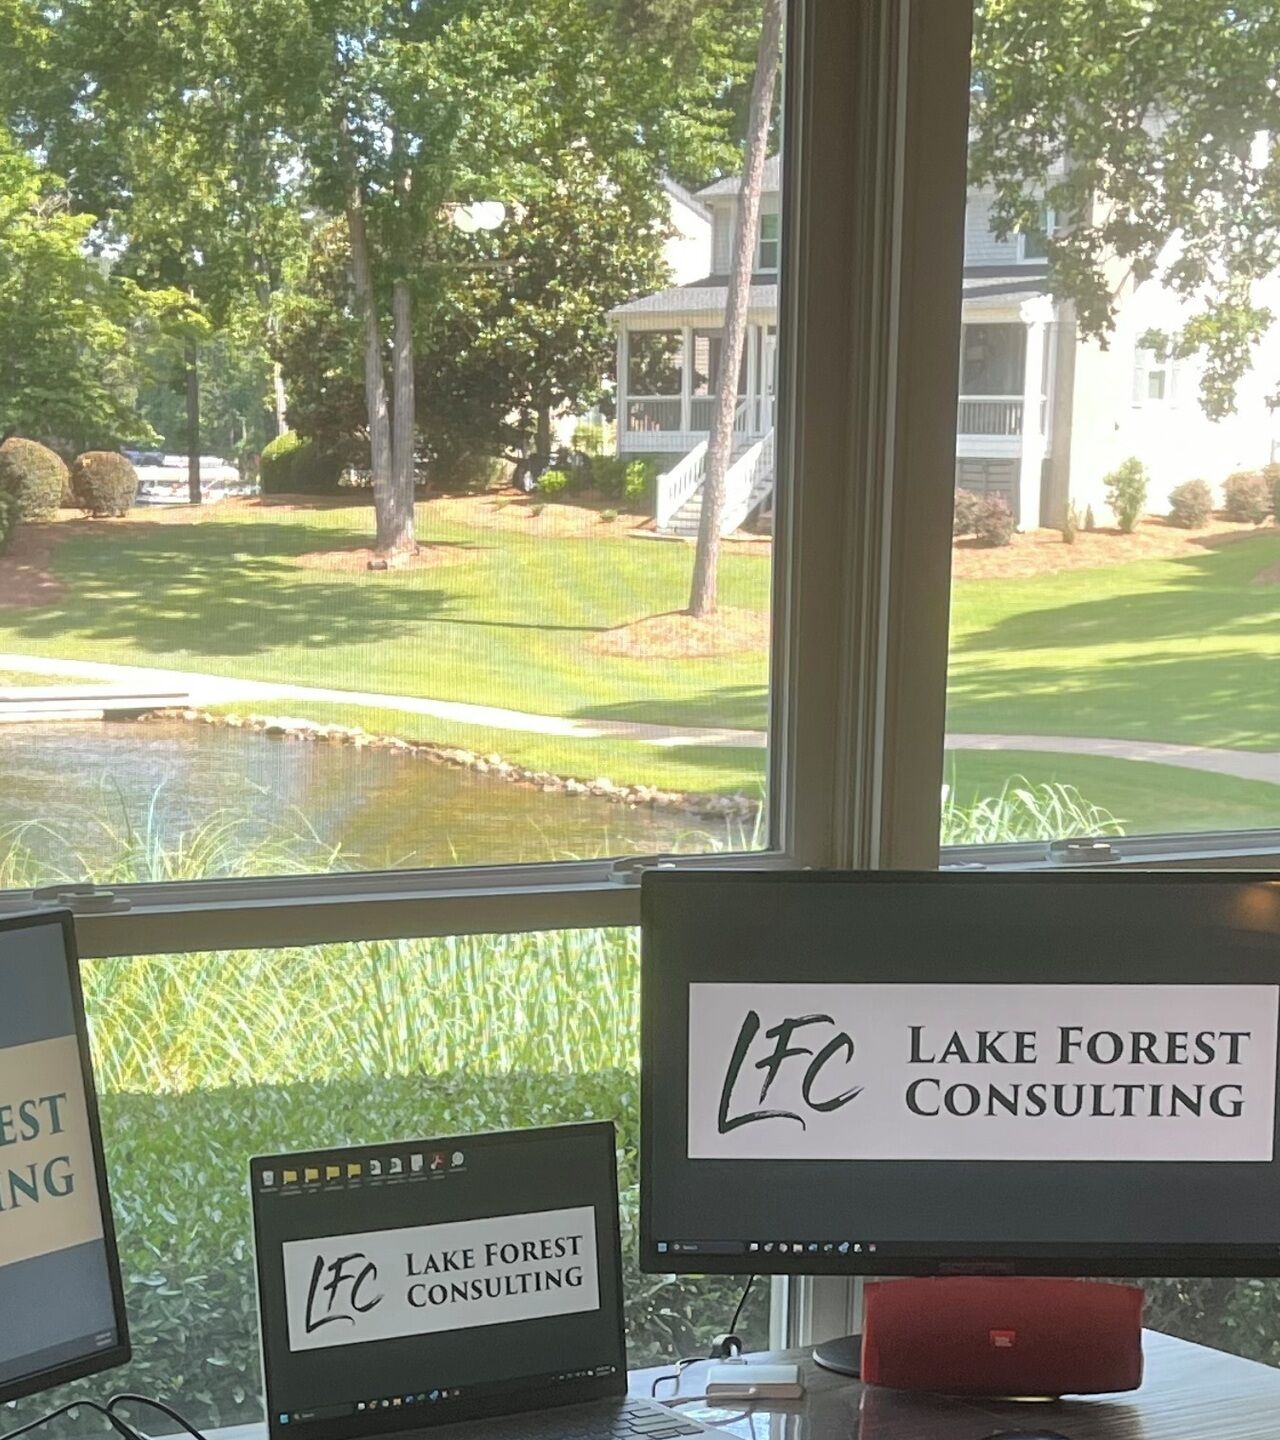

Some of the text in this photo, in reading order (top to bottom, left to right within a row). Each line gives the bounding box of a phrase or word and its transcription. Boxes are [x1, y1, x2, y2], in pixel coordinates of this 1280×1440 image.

[718, 1010, 1252, 1134] LFC LAKE FOREST
[905, 1078, 1245, 1119] CONSULTING
[305, 1235, 584, 1333] LFC LAKE FOREST
[407, 1266, 584, 1308] CONSULTING
